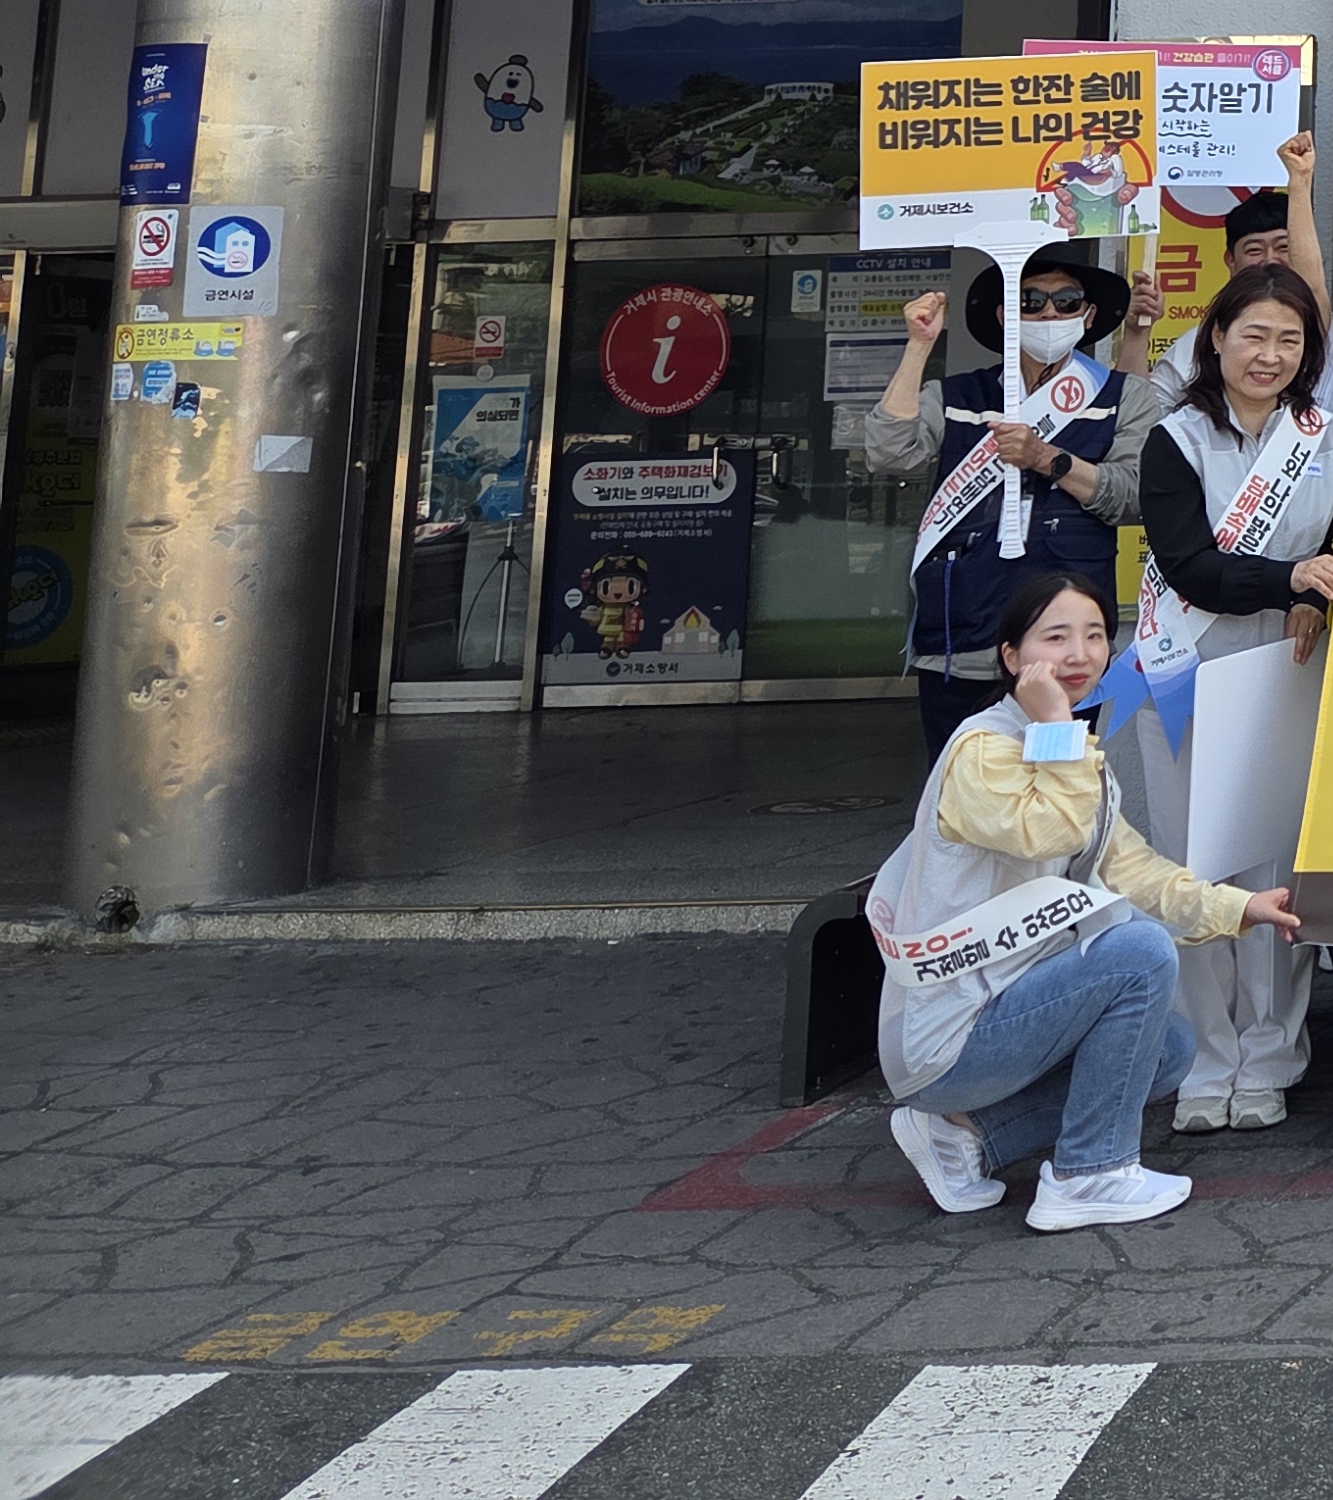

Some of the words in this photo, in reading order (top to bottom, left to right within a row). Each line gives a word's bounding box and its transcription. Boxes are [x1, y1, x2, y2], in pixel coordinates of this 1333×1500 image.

[1172, 51, 1215, 65] 건강습관
[1263, 52, 1284, 65] 레드
[876, 76, 1004, 113] 채워지는
[1009, 72, 1075, 107] 한잔
[1080, 69, 1142, 104] 술에
[1161, 81, 1275, 115] 숫자알기
[877, 117, 1004, 152] 비워지는
[1010, 113, 1075, 145] 나의
[1080, 108, 1144, 144] 건강
[1161, 118, 1211, 134] 시작하는
[1206, 141, 1237, 158] 관리!
[898, 201, 975, 218] 거제시보건소
[855, 258, 884, 269] CCTV
[886, 257, 907, 269] 설치
[910, 256, 932, 268] 안내
[1155, 244, 1203, 293] 금
[204, 289, 255, 301] 금연시설
[622, 291, 659, 316] 거제시
[659, 286, 715, 318] 관광안내소
[136, 328, 195, 346] 금연정류소
[605, 370, 631, 409] Tourist
[630, 393, 695, 416] Information
[694, 369, 722, 399] Center
[1283, 441, 1312, 483] 너와
[582, 466, 635, 481] 소화기와
[598, 486, 638, 501] 설치는
[640, 484, 710, 500] 의무입니다!
[1258, 478, 1292, 518] 나의
[622, 660, 680, 675] 거제소방서
